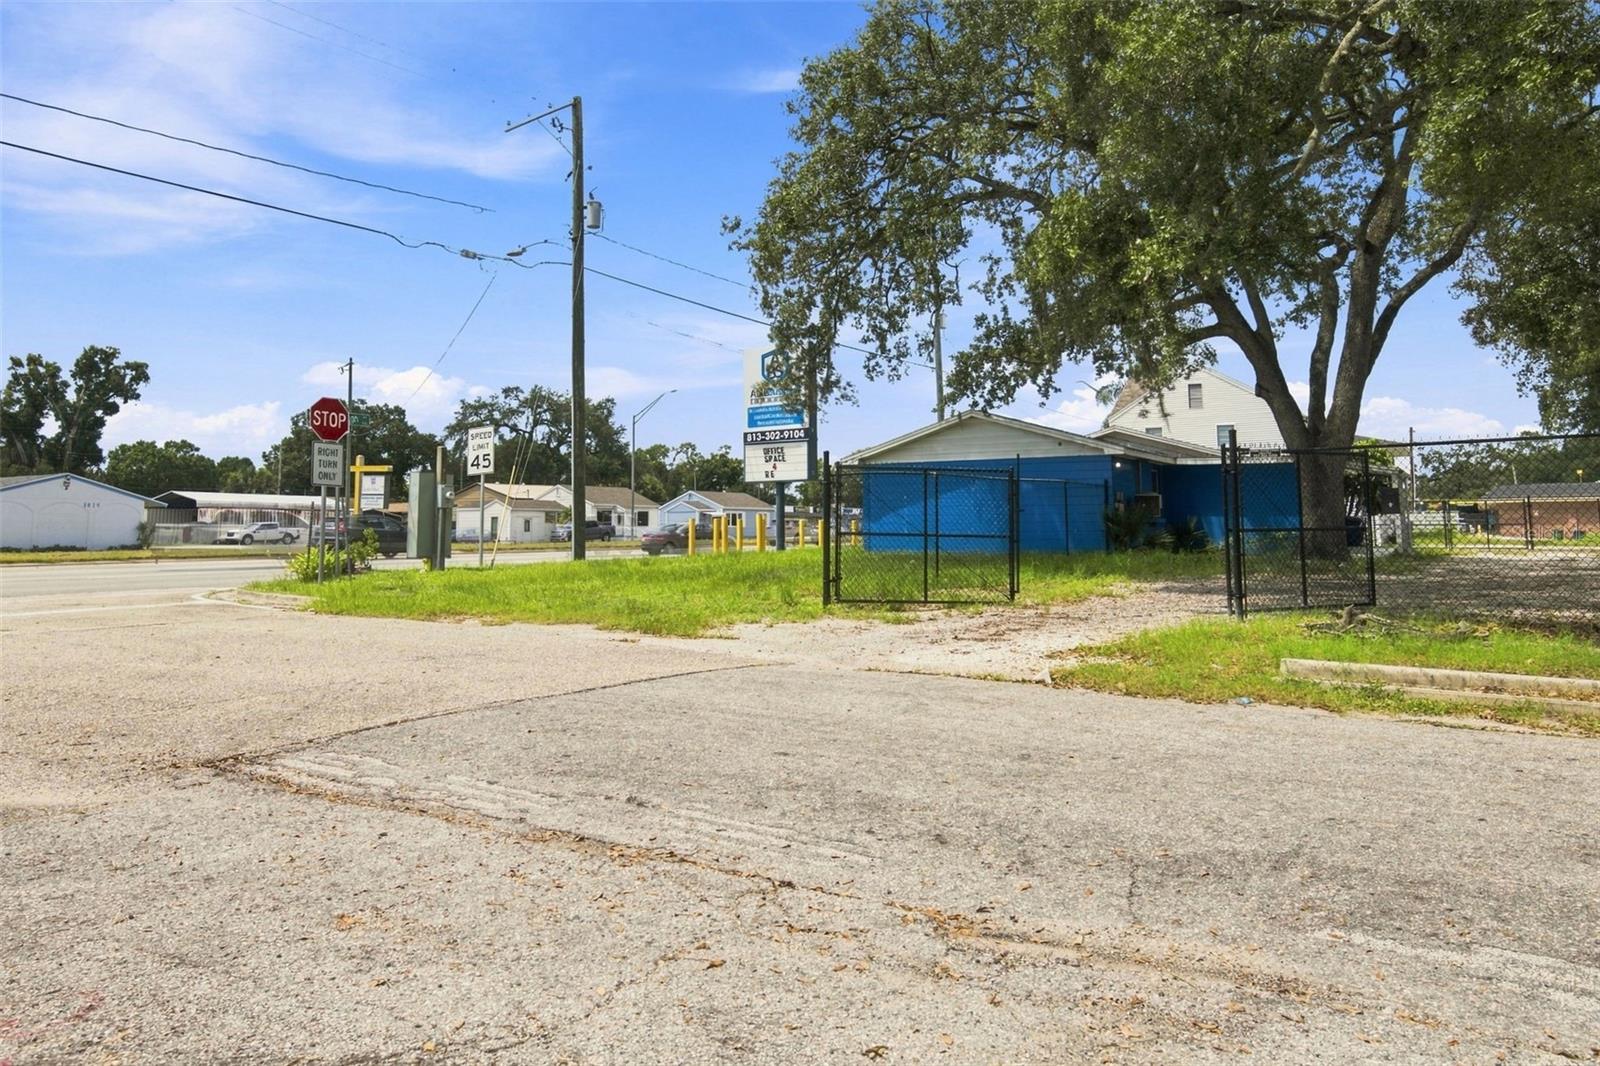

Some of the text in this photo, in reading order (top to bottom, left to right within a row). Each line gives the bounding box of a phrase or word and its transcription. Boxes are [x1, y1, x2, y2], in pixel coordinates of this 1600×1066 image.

[313, 410, 346, 428] STOP
[470, 431, 492, 440] SPEED
[746, 429, 805, 442] 813-302-9104
[472, 443, 489, 451] LIMIT
[763, 447, 785, 455] OFFICE
[317, 447, 339, 457] RIGHT
[318, 459, 338, 468] TURN
[470, 453, 492, 469] 45
[764, 455, 786, 463] SPACE
[318, 471, 337, 481] ONLY
